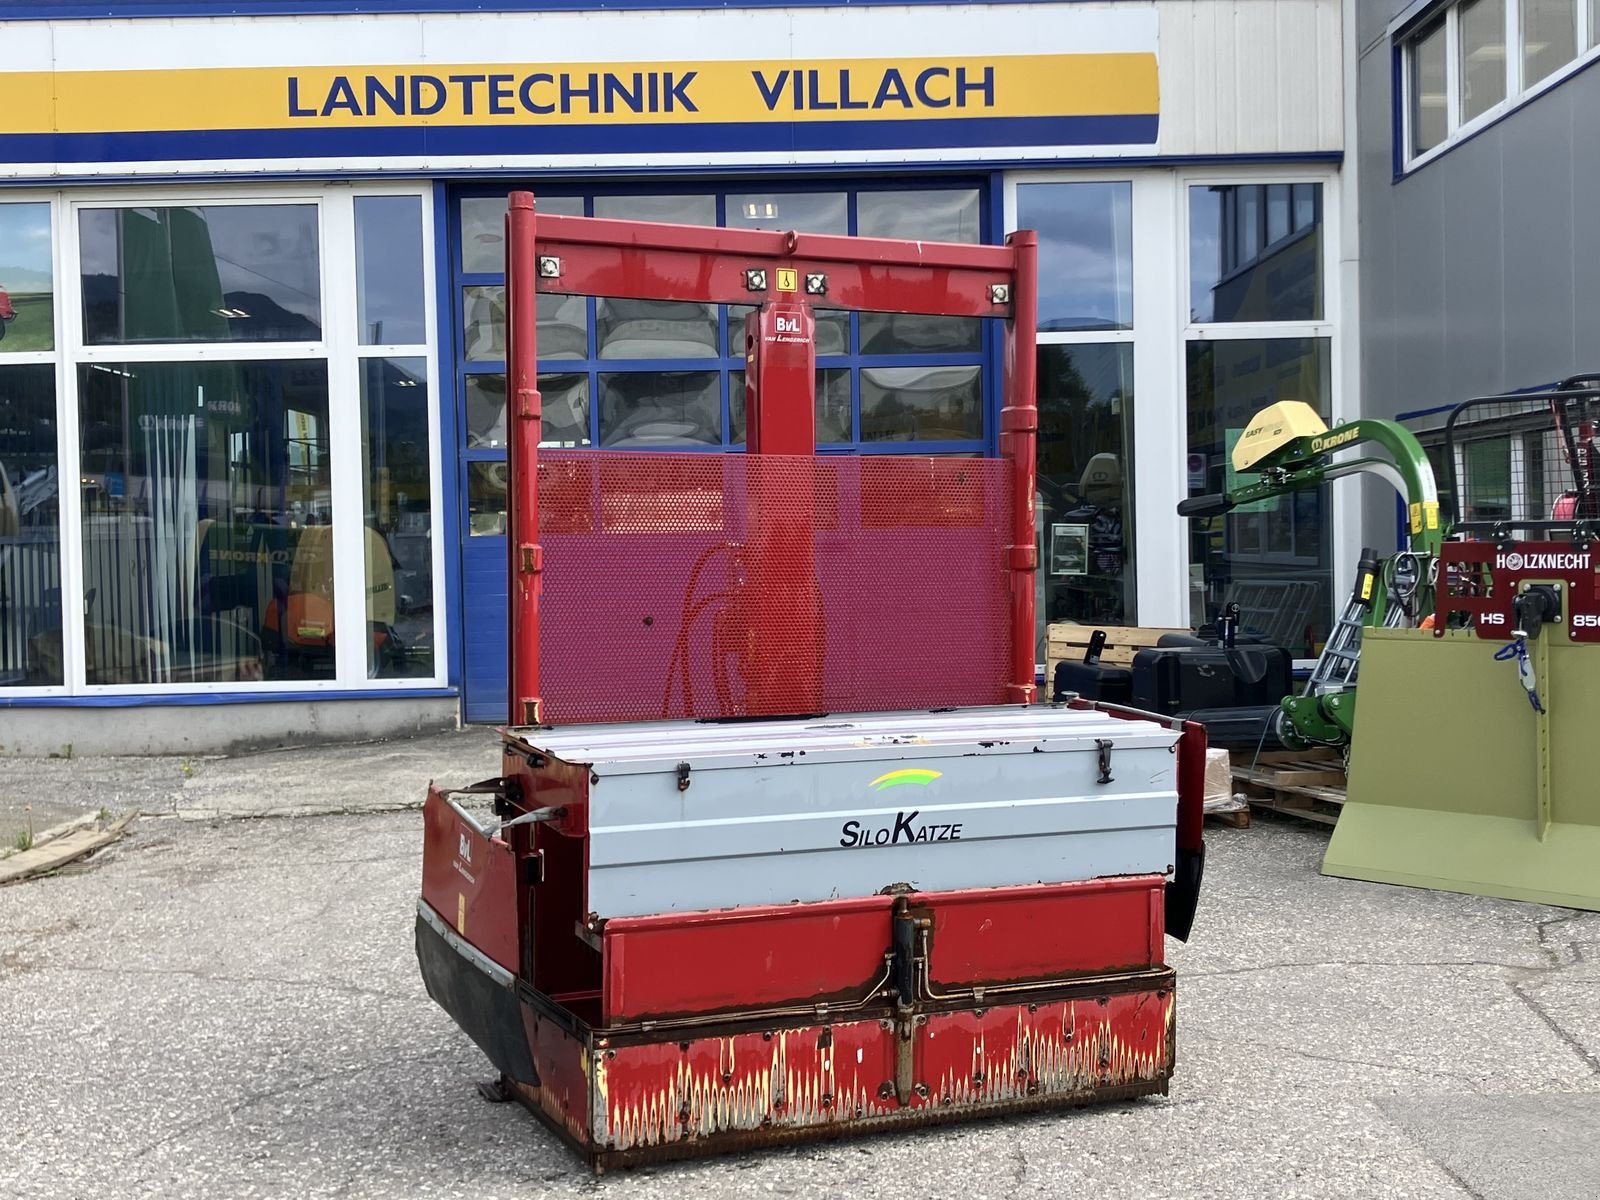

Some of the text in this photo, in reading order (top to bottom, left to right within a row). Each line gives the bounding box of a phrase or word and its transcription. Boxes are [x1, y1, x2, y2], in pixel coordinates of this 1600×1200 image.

[287, 66, 995, 118] LANDTECHNIK VILLACH
[1322, 426, 1361, 450] KRONE
[1480, 612, 1505, 625] HS
